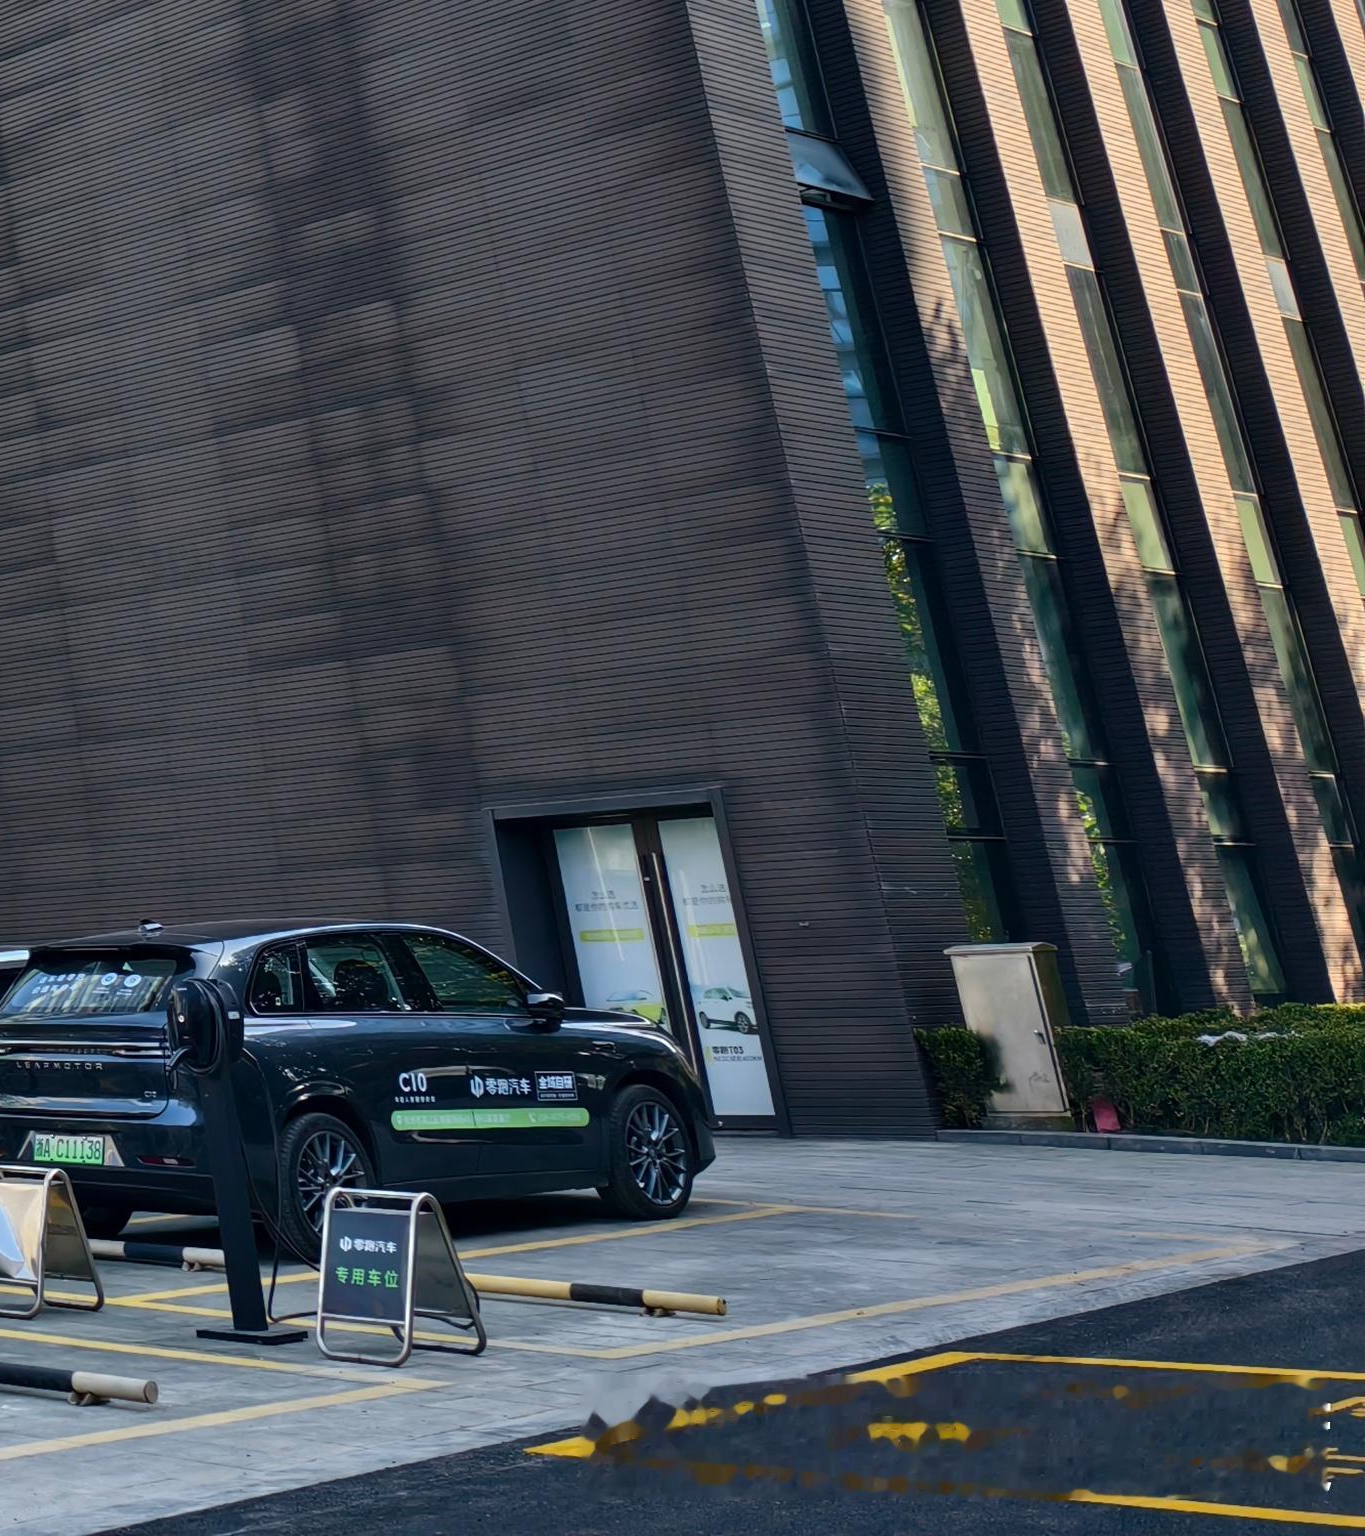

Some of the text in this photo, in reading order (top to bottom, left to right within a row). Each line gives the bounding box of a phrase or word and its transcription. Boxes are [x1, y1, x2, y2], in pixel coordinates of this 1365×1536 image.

[398, 1072, 428, 1093] C10
[484, 1077, 532, 1096] 零跑汽车
[353, 1238, 398, 1254] 零跑汽车
[335, 1265, 399, 1289] 专用车位
